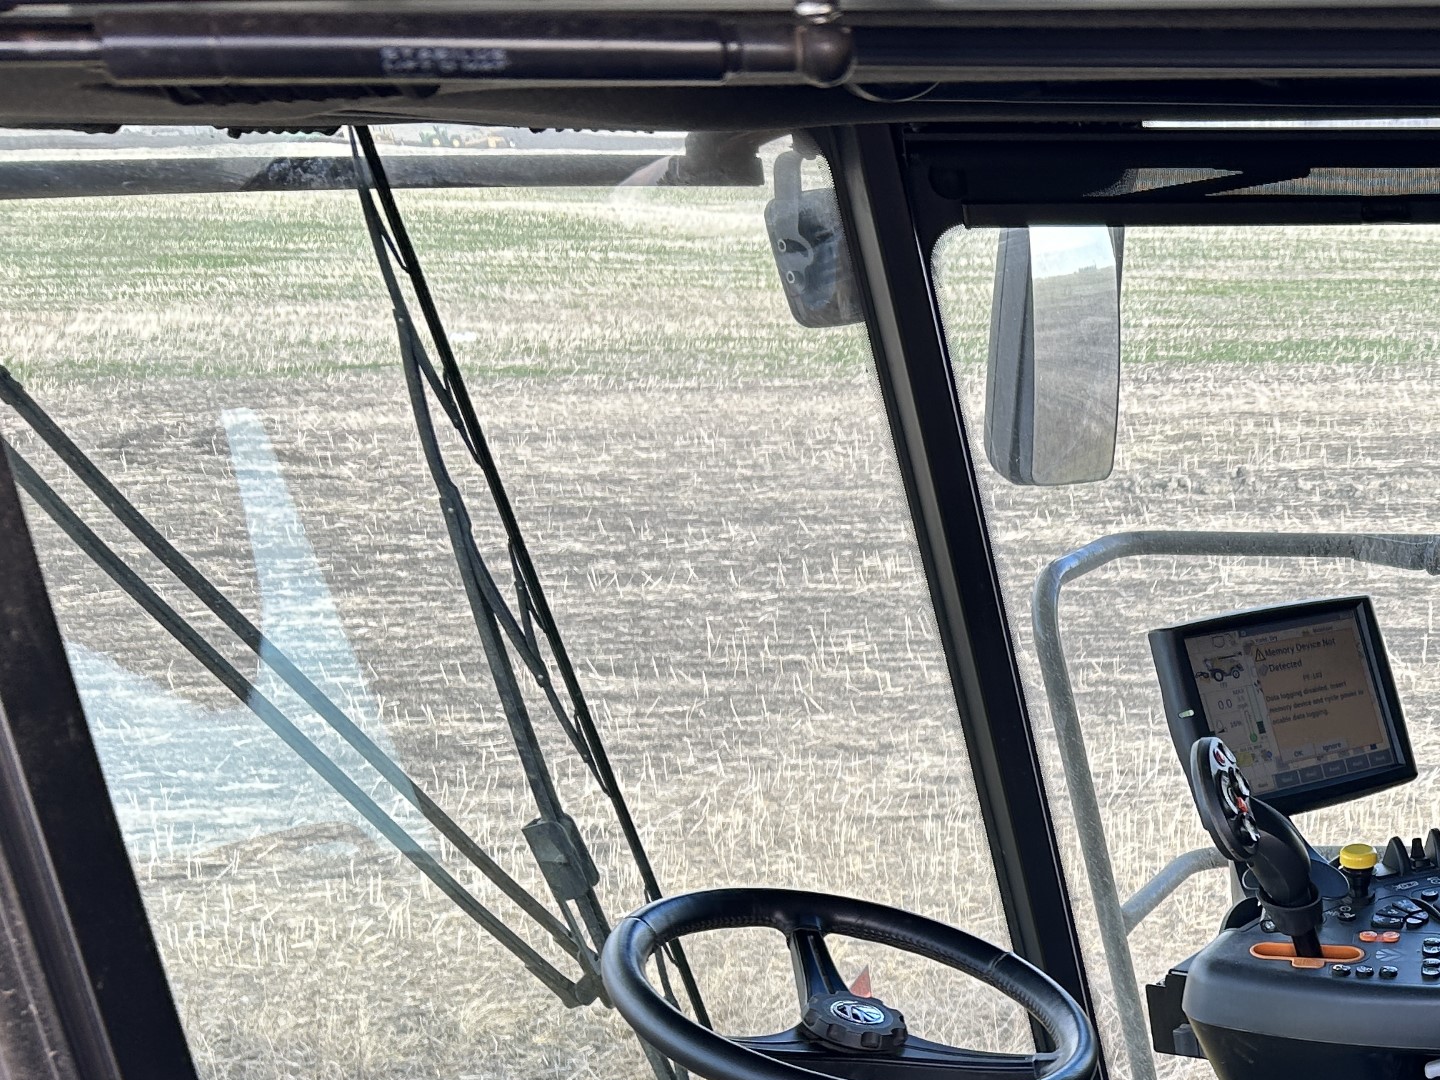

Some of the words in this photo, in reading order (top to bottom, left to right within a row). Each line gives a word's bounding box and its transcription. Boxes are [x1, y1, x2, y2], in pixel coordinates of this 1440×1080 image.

[1264, 646, 1295, 657] Memory
[1295, 641, 1321, 652] Device
[1322, 637, 1336, 647] Not
[1268, 659, 1303, 673] Detected
[1217, 698, 1233, 710] 0.0
[1322, 742, 1342, 753] Ignore
[1293, 750, 1304, 758] OK
